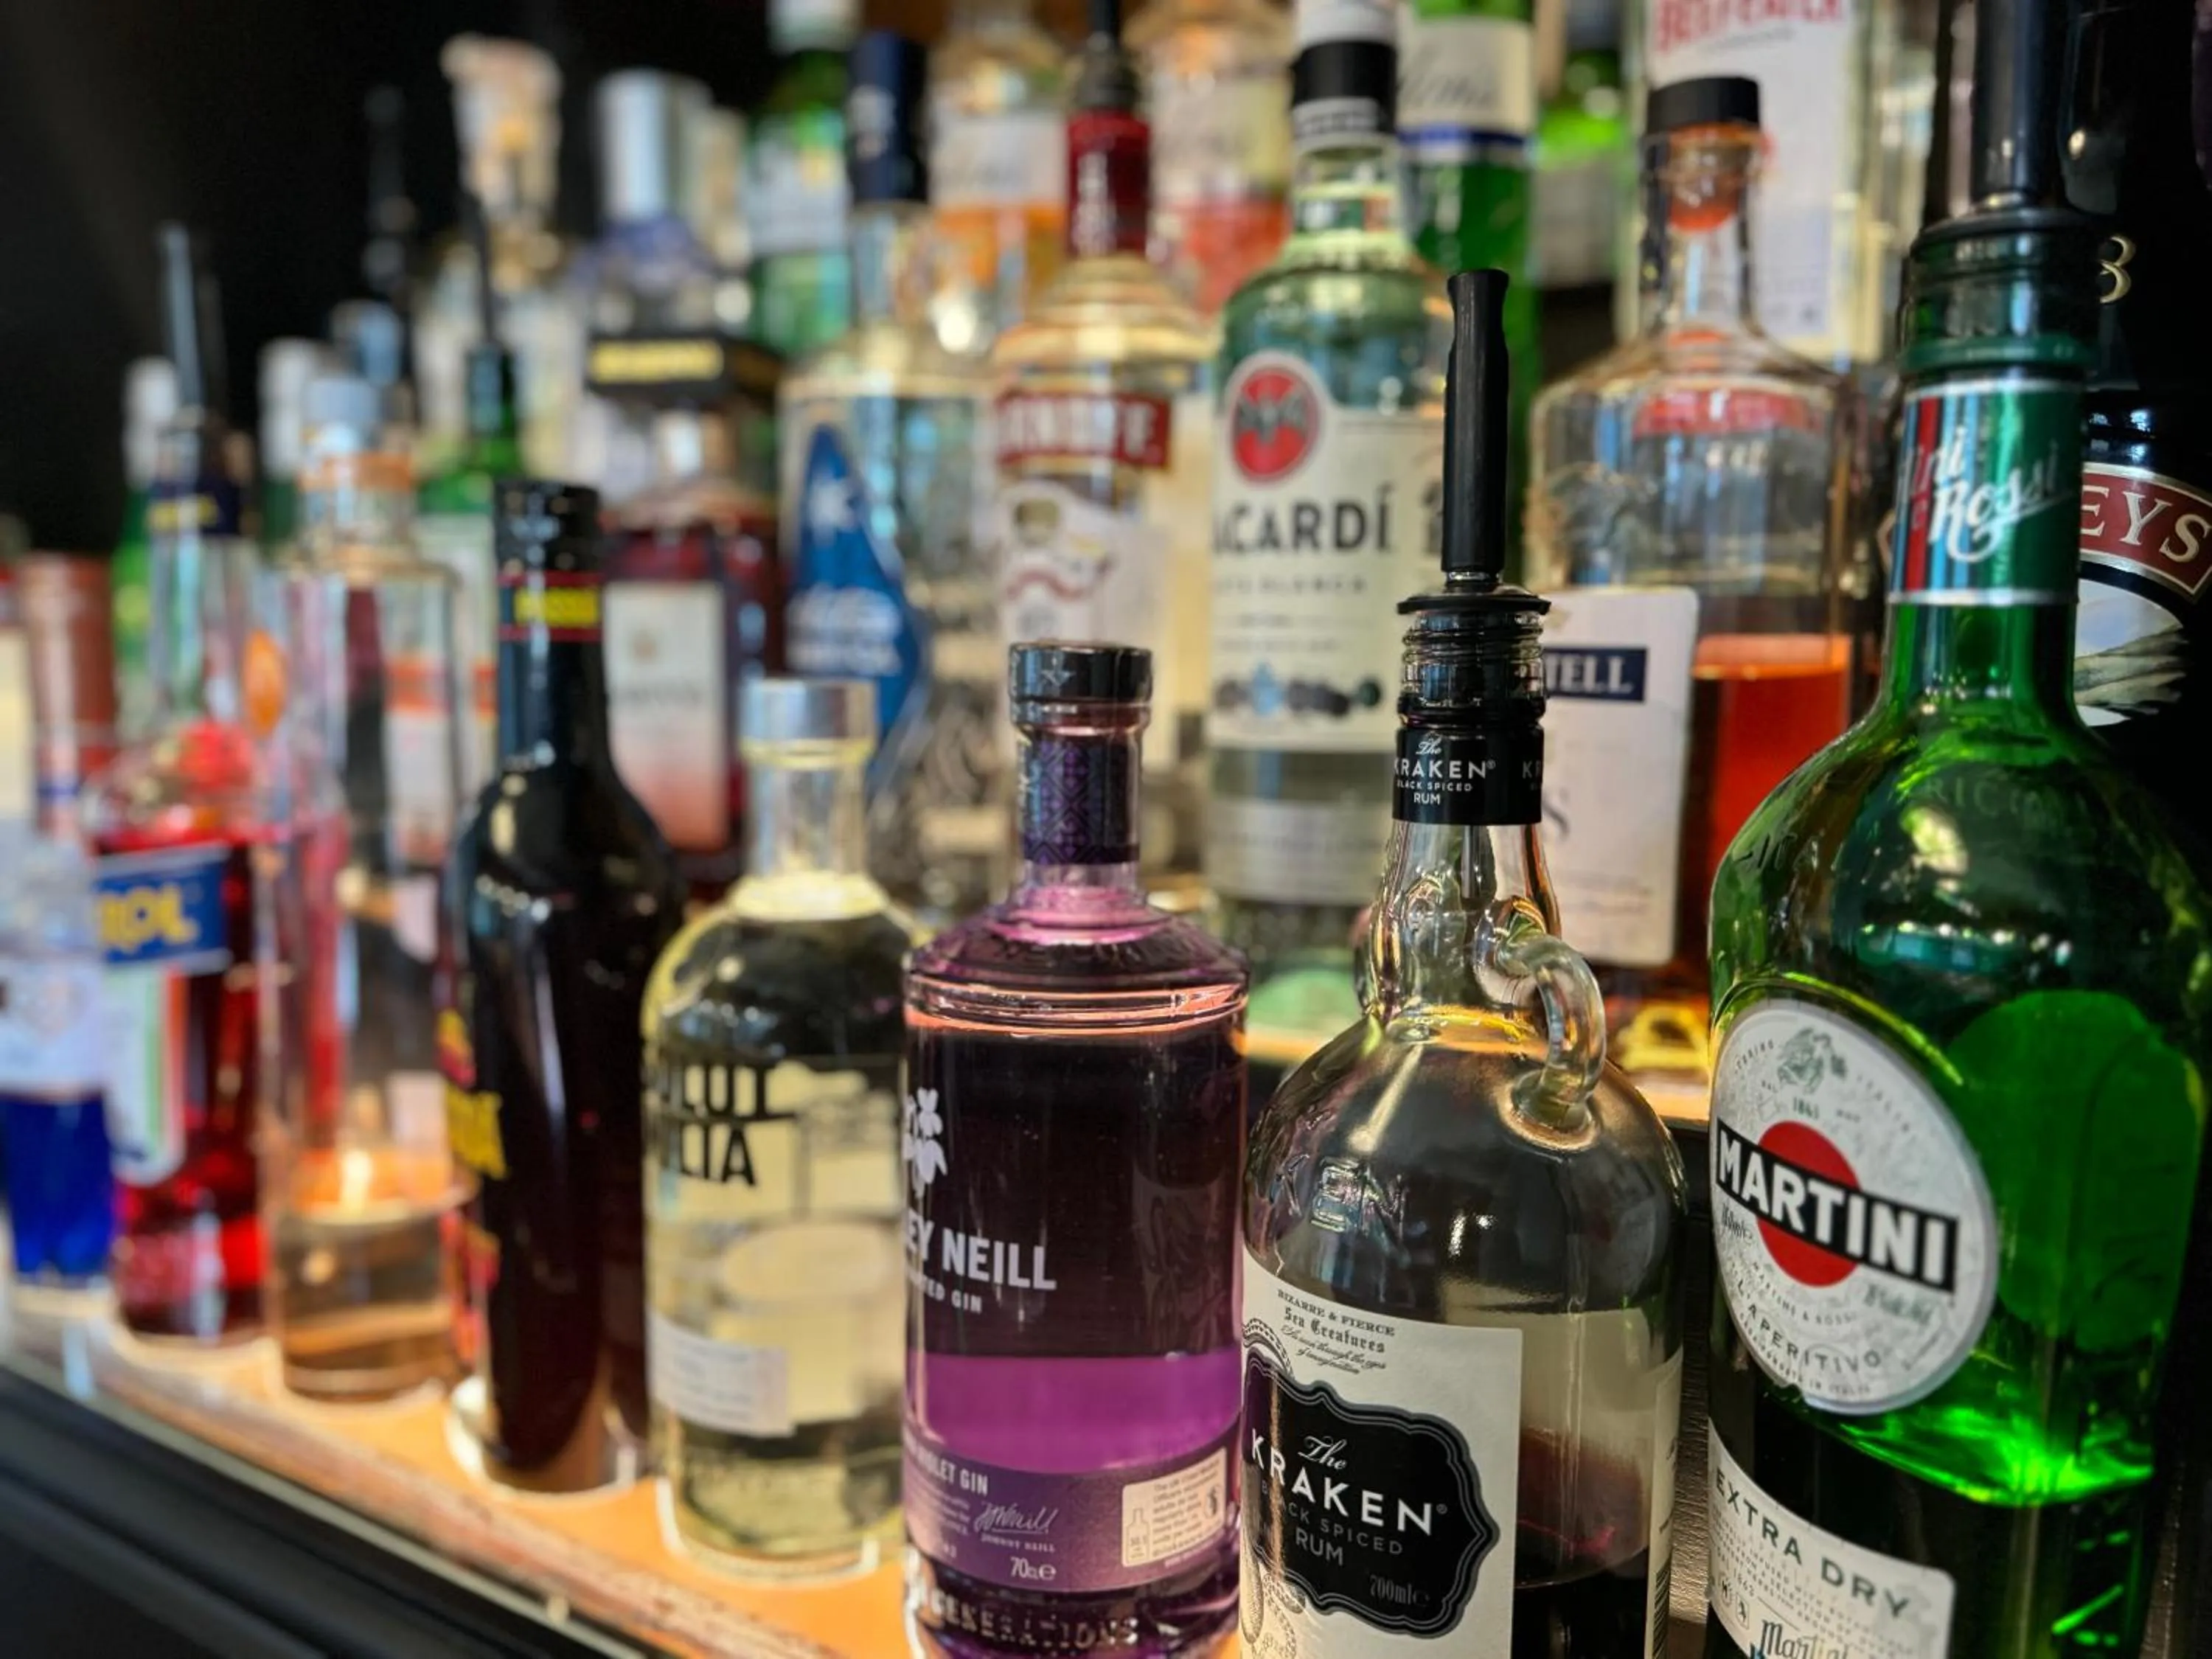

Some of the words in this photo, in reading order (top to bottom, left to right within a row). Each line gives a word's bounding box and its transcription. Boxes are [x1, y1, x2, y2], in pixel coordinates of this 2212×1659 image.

[1413, 792, 1441, 805] RUM
[1427, 782, 1473, 792] SPICED
[1719, 1129, 1947, 1285] MARTINI
[942, 1226, 1058, 1291] NEILL
[950, 1288, 983, 1315] GIN
[1277, 1289, 1326, 1318] BIZARRE
[1328, 1312, 1338, 1321] &
[1341, 1315, 1396, 1337] FIERCE
[1284, 1306, 1305, 1328] Sea
[1310, 1318, 1385, 1354] Creatures
[1297, 1435, 1348, 1470] The
[960, 1467, 989, 1496] GIN
[1252, 1428, 1432, 1536] KRAKEN
[1295, 1526, 1344, 1567] RUM
[1320, 1517, 1403, 1557] SPICED
[1716, 1467, 1803, 1566] EXTRA
[1820, 1555, 1911, 1619] DRY
